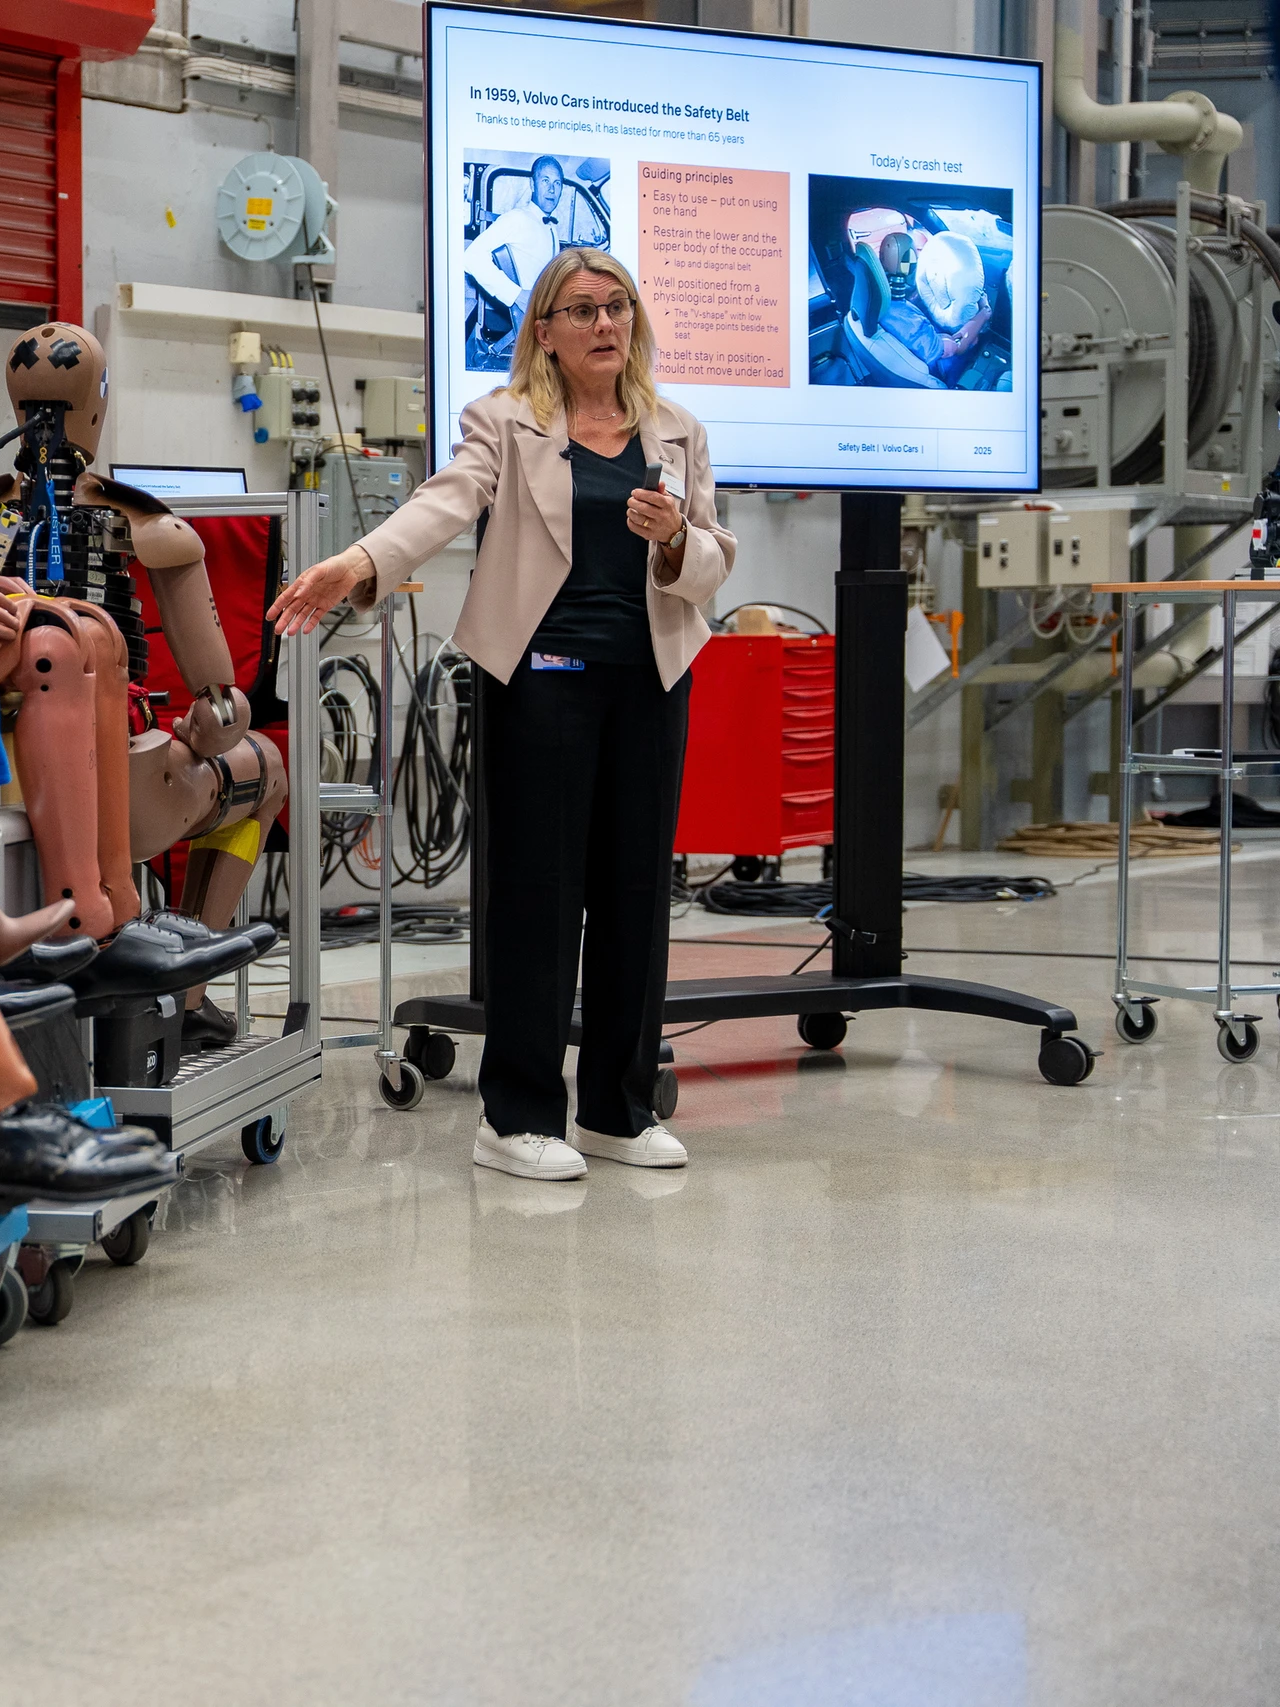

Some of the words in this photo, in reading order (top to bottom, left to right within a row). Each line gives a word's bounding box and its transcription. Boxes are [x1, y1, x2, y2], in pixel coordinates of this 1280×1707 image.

[470, 86, 481, 99] In
[485, 87, 520, 105] 1959,
[523, 90, 558, 105] Volvo
[561, 94, 590, 109] Cars
[593, 96, 659, 114] introduced
[662, 103, 682, 116] the
[684, 105, 723, 123] Safety
[726, 108, 750, 122] Belt
[476, 112, 508, 126] Thanks
[511, 117, 520, 126] to
[522, 117, 547, 128] these
[549, 119, 594, 133] principles,
[595, 122, 601, 133] it
[603, 123, 619, 134] has
[621, 124, 647, 136] lasted
[649, 126, 661, 137] for
[663, 129, 686, 139] more
[687, 130, 706, 141] than
[708, 132, 720, 142] 65
[722, 134, 745, 145] years
[912, 158, 941, 172] crash
[943, 161, 963, 174] test
[642, 167, 682, 183] Guiding
[685, 171, 734, 185] principles
[653, 190, 676, 204] Easy
[679, 192, 689, 203] to
[691, 195, 708, 204] use
[720, 195, 736, 208] put
[738, 197, 750, 207] on
[752, 198, 778, 211] using
[653, 206, 671, 216] one
[673, 205, 697, 218] hand
[653, 225, 693, 239] Restrain
[695, 228, 711, 240] the
[713, 229, 739, 241] lower
[742, 232, 759, 243] and
[762, 233, 777, 244] the
[653, 242, 681, 253] upper
[683, 241, 707, 255] body
[709, 243, 720, 254] of
[722, 244, 736, 255] the
[739, 247, 783, 259] occupant
[674, 259, 686, 269] lap
[687, 260, 701, 269] and
[703, 260, 735, 272] diagonal
[737, 262, 752, 272] belt
[653, 276, 675, 288] Well
[678, 278, 727, 291] positioned
[730, 280, 752, 292] from
[754, 283, 760, 293] a
[653, 290, 715, 306] physiological
[718, 294, 742, 308] point
[744, 295, 754, 306] of
[756, 296, 778, 307] view
[674, 308, 688, 318] The
[730, 311, 746, 321] with
[748, 312, 762, 321] low
[674, 320, 714, 332] anchorage
[716, 322, 739, 332] points
[741, 323, 765, 333] beside
[767, 324, 779, 334] the
[674, 331, 691, 340] seat
[656, 347, 671, 360] he
[674, 349, 692, 361] belt
[694, 351, 714, 363] stay
[717, 351, 724, 362] in
[727, 352, 764, 364] position
[654, 362, 686, 374] should
[688, 364, 704, 375] not
[706, 366, 732, 376] move
[735, 366, 762, 378] under
[764, 367, 784, 379] load
[838, 442, 860, 454] Safety
[861, 443, 875, 452] Belt
[882, 443, 902, 453] Volvo
[903, 444, 919, 453] Cars
[974, 446, 992, 455] 2025
